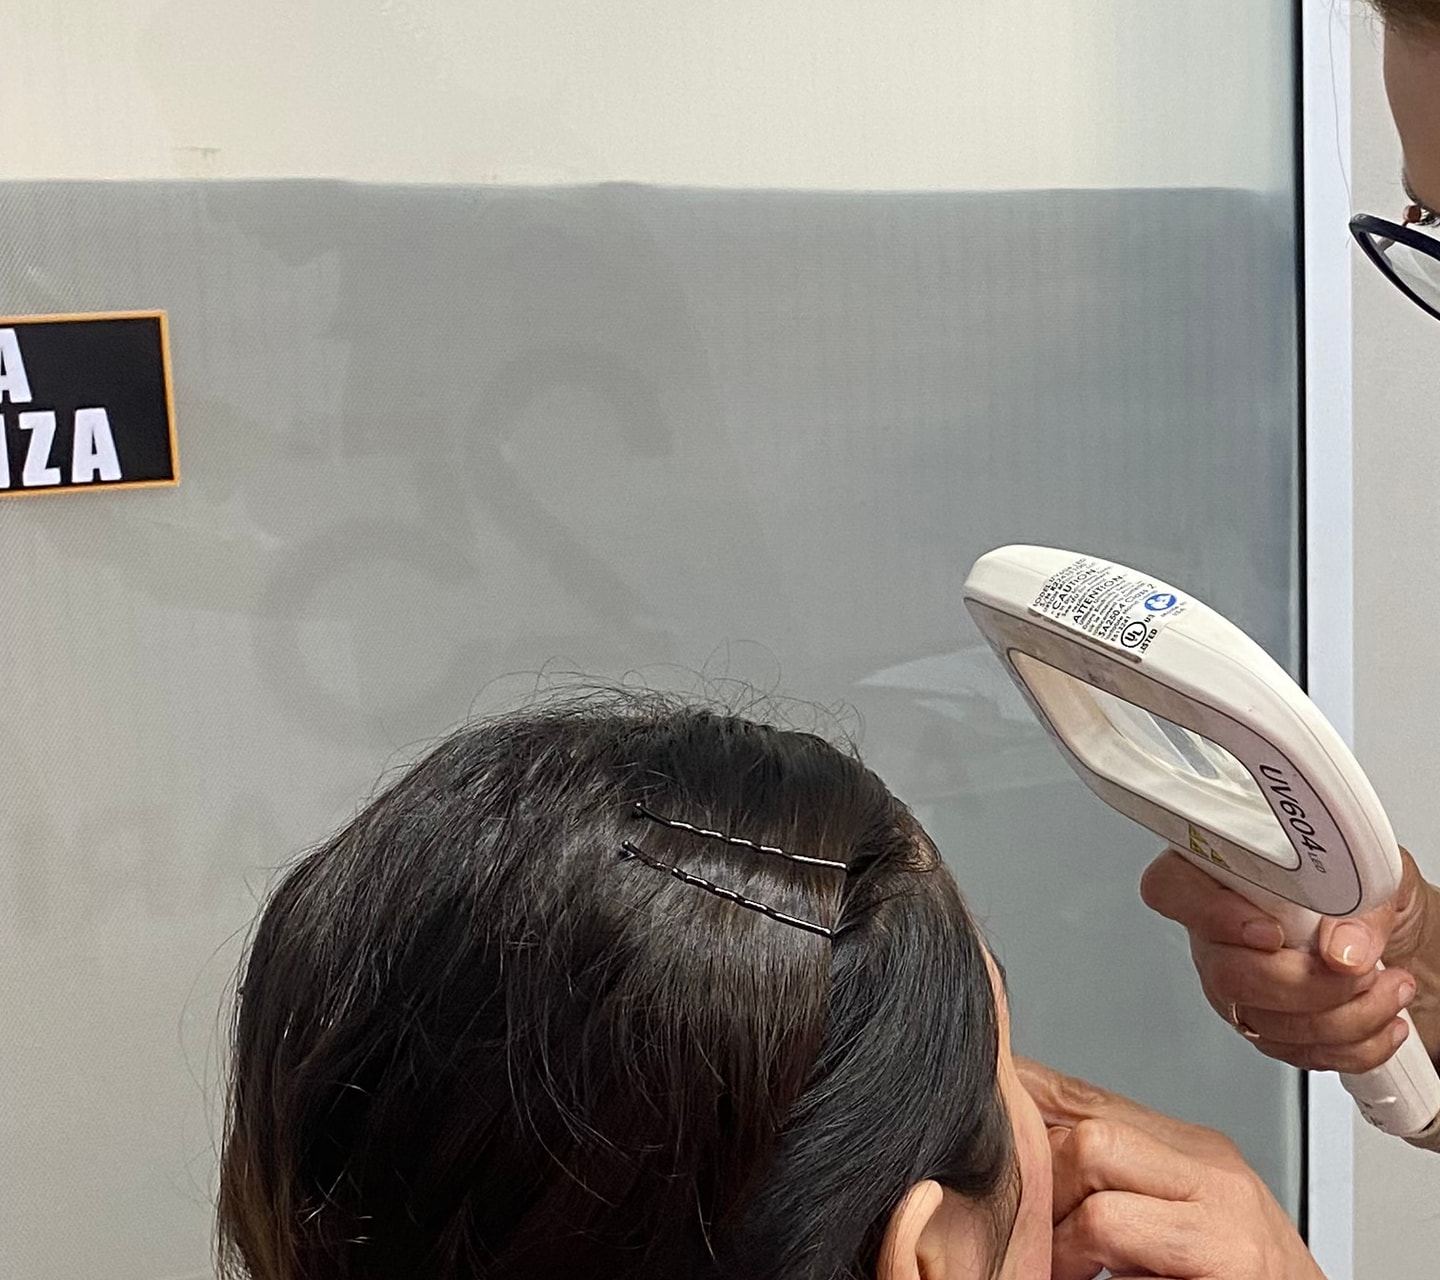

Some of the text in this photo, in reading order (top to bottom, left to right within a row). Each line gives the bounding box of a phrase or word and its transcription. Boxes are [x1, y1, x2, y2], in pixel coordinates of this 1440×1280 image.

[1052, 569, 1097, 610] CAUTION
[1073, 574, 1123, 624] ATTENTION
[1124, 630, 1144, 641] UL
[1259, 764, 1327, 853] UV604
